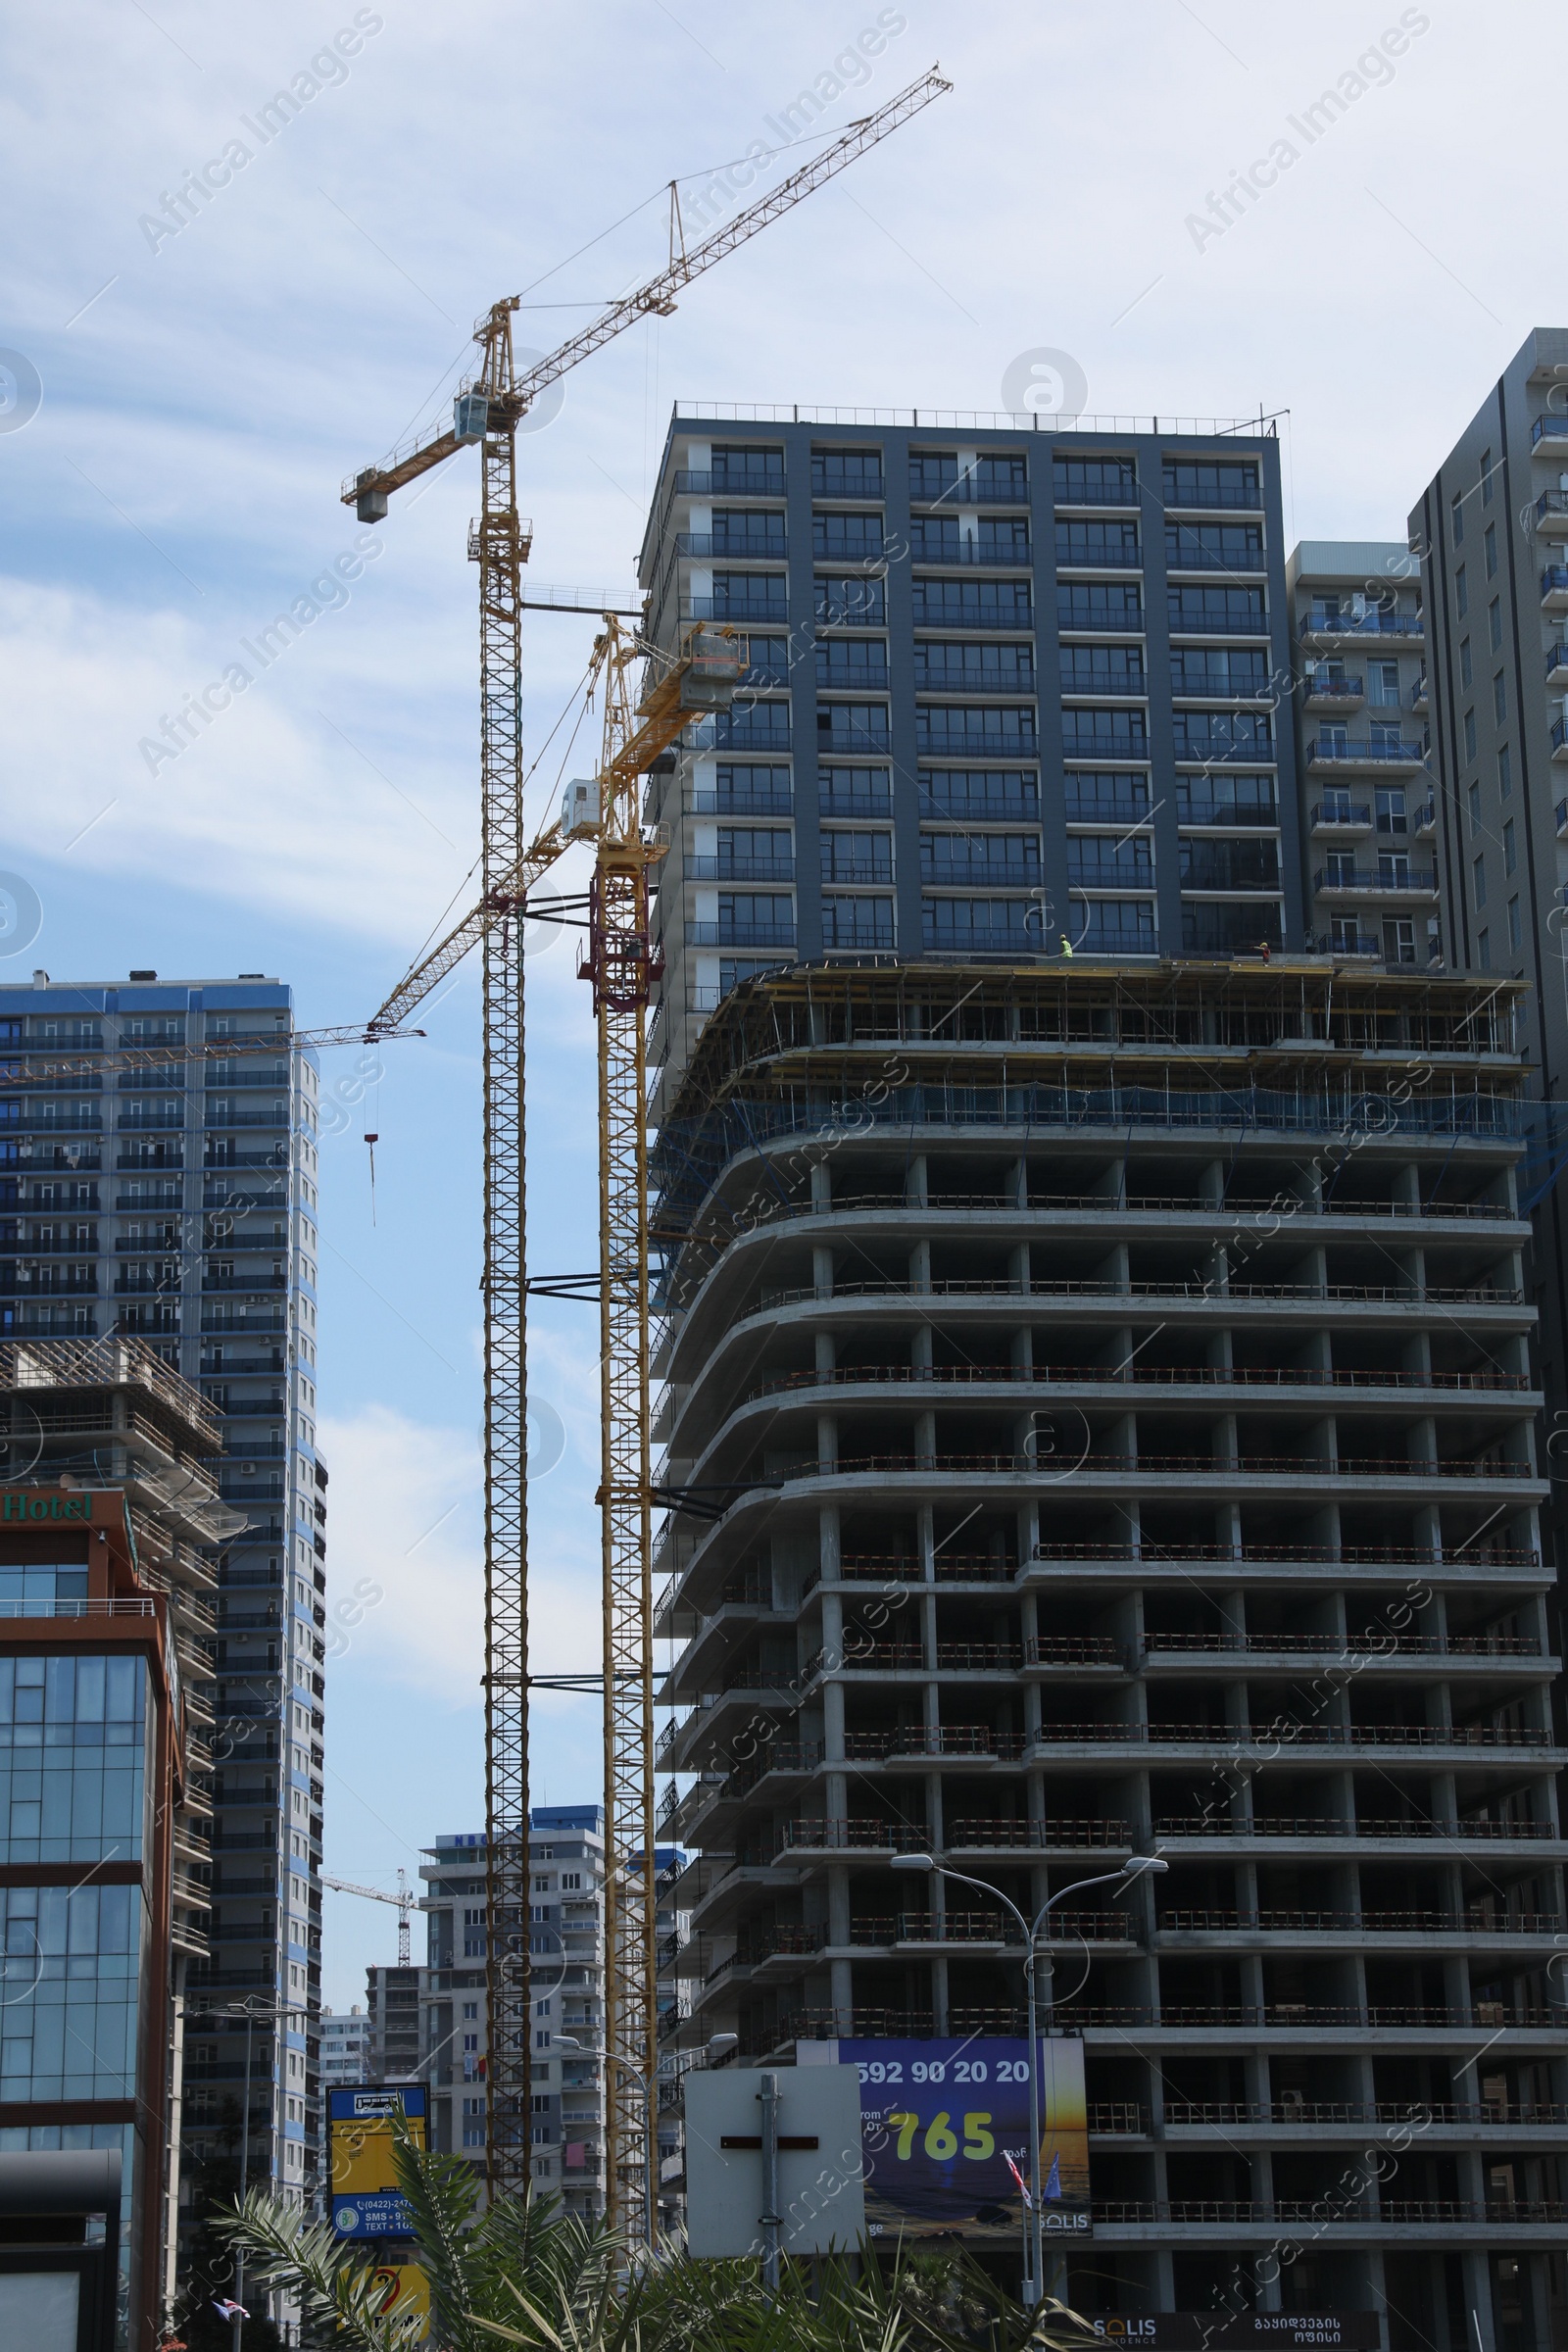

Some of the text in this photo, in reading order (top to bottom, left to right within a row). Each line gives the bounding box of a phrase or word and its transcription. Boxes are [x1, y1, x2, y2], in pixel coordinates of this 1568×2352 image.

[3, 1494, 92, 1521] Hotel
[855, 2060, 1030, 2083] 592 90 20 20
[889, 2111, 995, 2161] 765
[366, 2213, 387, 2222] SMS
[1094, 2319, 1156, 2335] SOLIS
[1254, 2318, 1341, 2329] გაყიდვების
[1295, 2331, 1341, 2342] ოფისი
